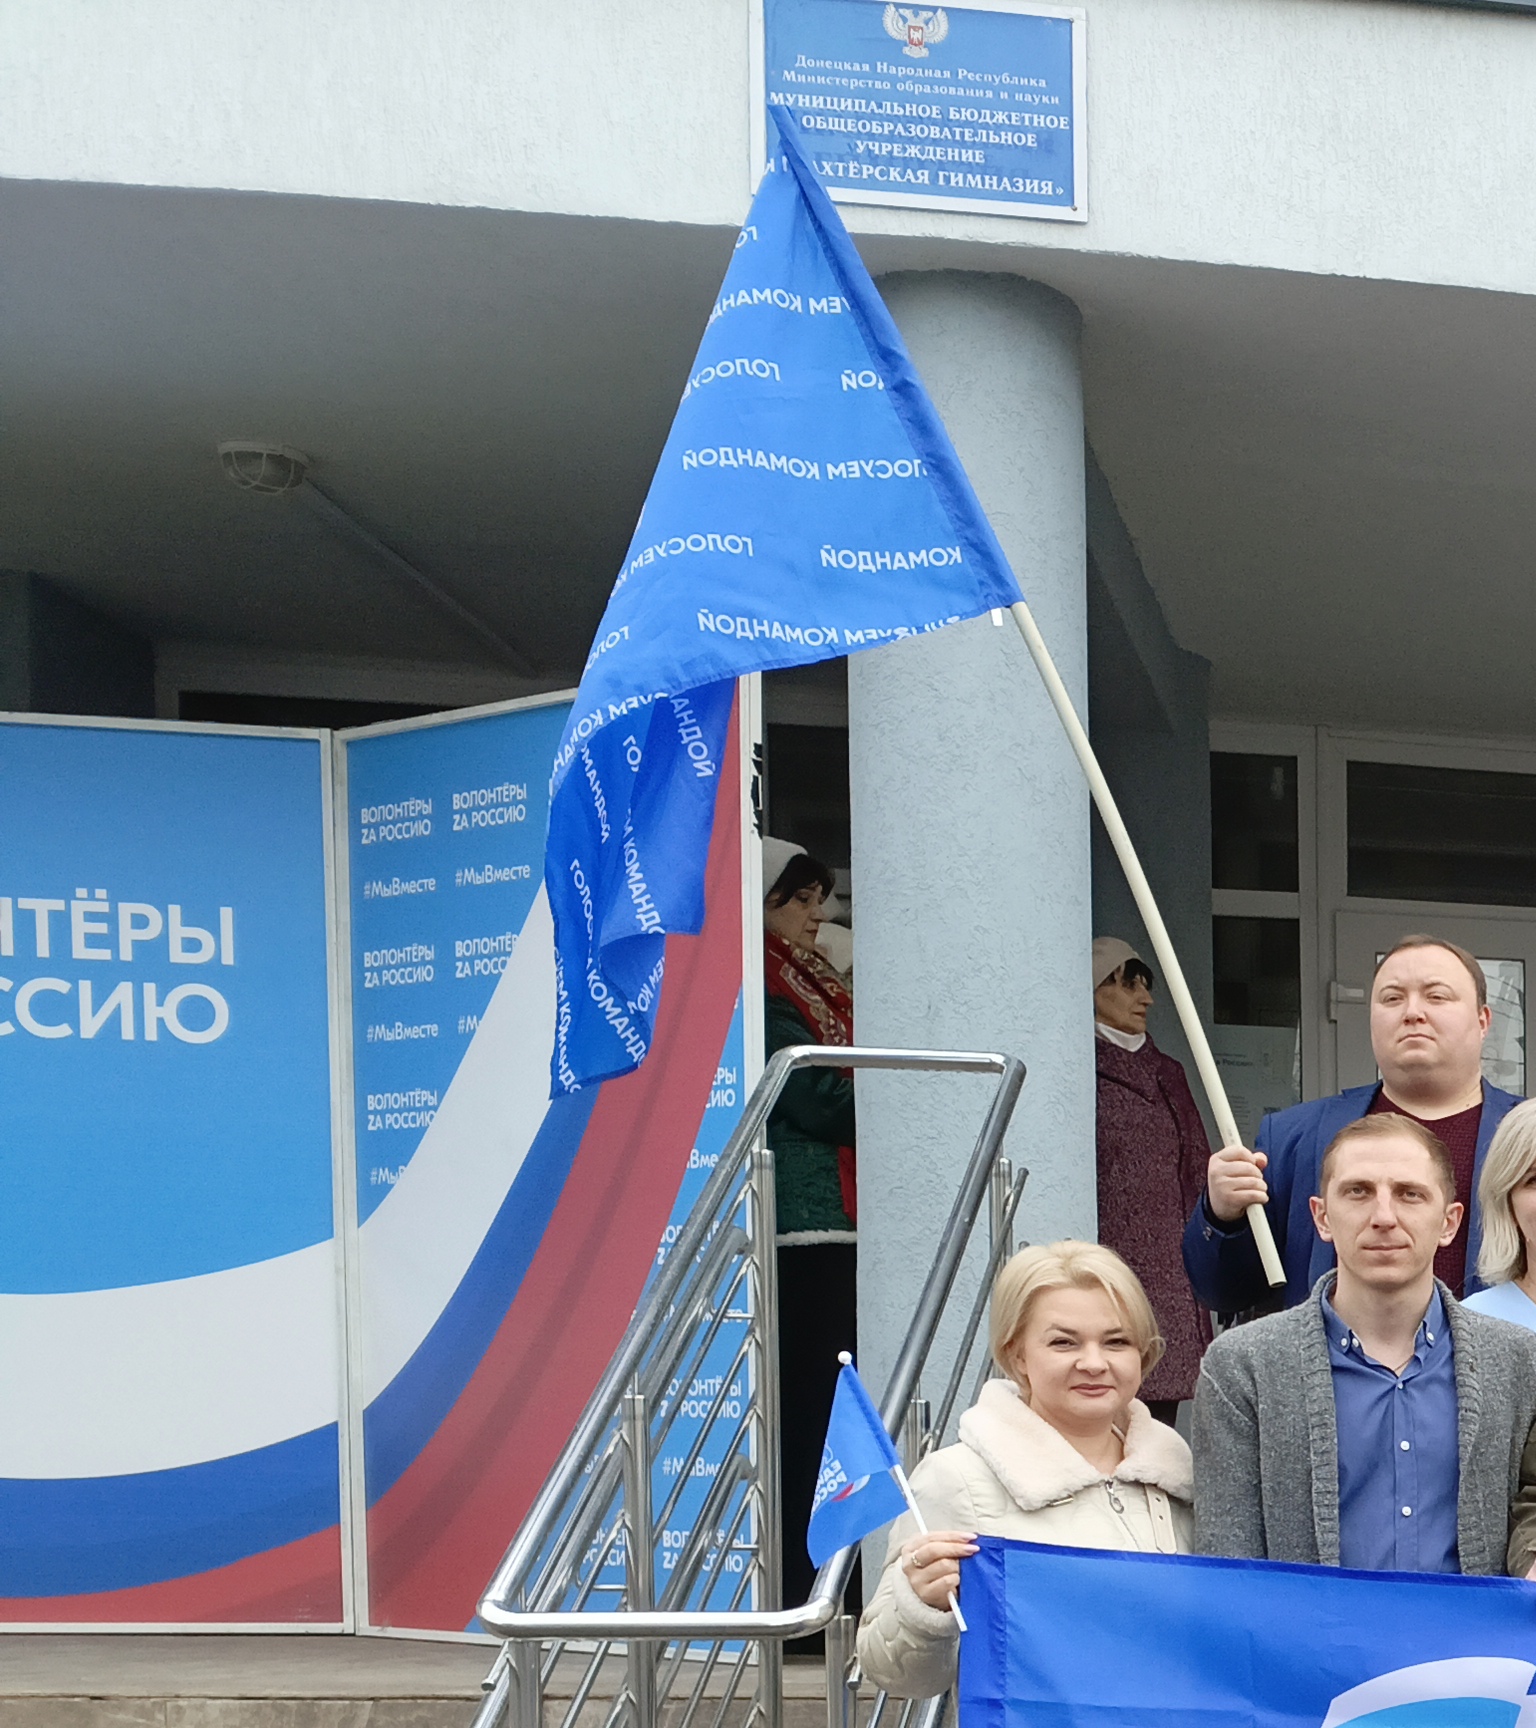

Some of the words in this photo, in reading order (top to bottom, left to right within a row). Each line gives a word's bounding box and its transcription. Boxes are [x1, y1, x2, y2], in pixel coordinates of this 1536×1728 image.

[795, 54, 870, 73] Донецкая
[876, 61, 951, 79] Народная
[957, 68, 1047, 88] Республика
[782, 70, 891, 90] Министерство
[896, 80, 994, 99] образования
[1000, 90, 1009, 100] и
[1015, 92, 1060, 106] науки
[770, 91, 942, 119] МУНИЦИПАЛЬНОЕ
[949, 106, 1070, 130] БЮДЖЕТНОЕ
[801, 114, 1037, 147] ОБЩЕОБРАЗОВАТЕЛЬНОЕ
[855, 140, 985, 164] УЧРЕЖДЕНИЕ
[452, 782, 527, 810] ВОЛОНТЁРЫ
[361, 797, 433, 824] ВОЛОНТЁРЫ
[471, 804, 527, 828] РОССИЮ
[379, 818, 432, 842] РОССИЮ
[455, 864, 531, 888] #МыВместе
[363, 877, 436, 900] #МыВместе
[363, 942, 435, 968] ВОЛОНТЁРЫ
[381, 964, 435, 987] РОССИЮ
[366, 1022, 439, 1043] #МыВместе
[367, 1088, 437, 1111] ВОЛОНТЁРЫ
